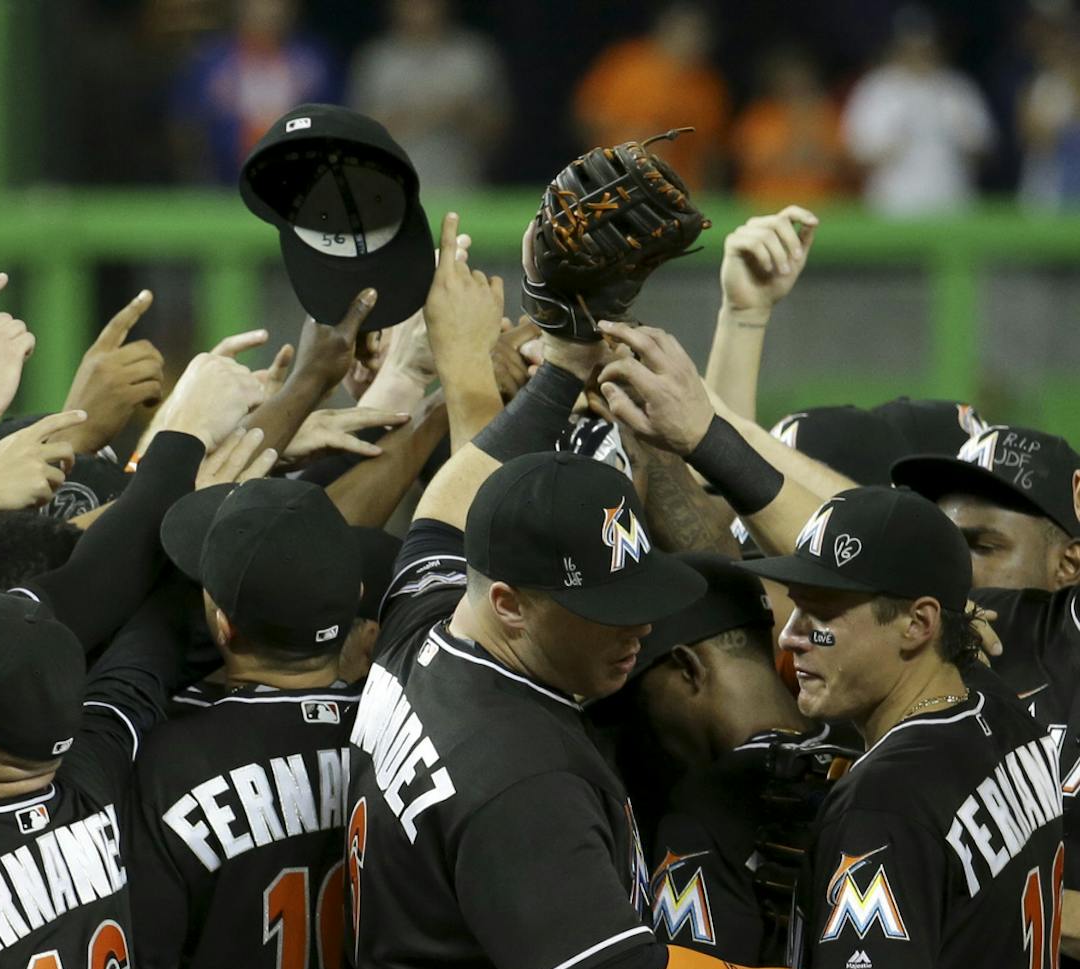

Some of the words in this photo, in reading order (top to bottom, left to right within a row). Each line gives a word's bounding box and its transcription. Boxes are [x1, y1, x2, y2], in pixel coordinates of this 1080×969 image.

[993, 448, 1032, 468] JDF
[1013, 468, 1035, 489] 16
[835, 541, 853, 560] 16
[819, 863, 910, 944] M
